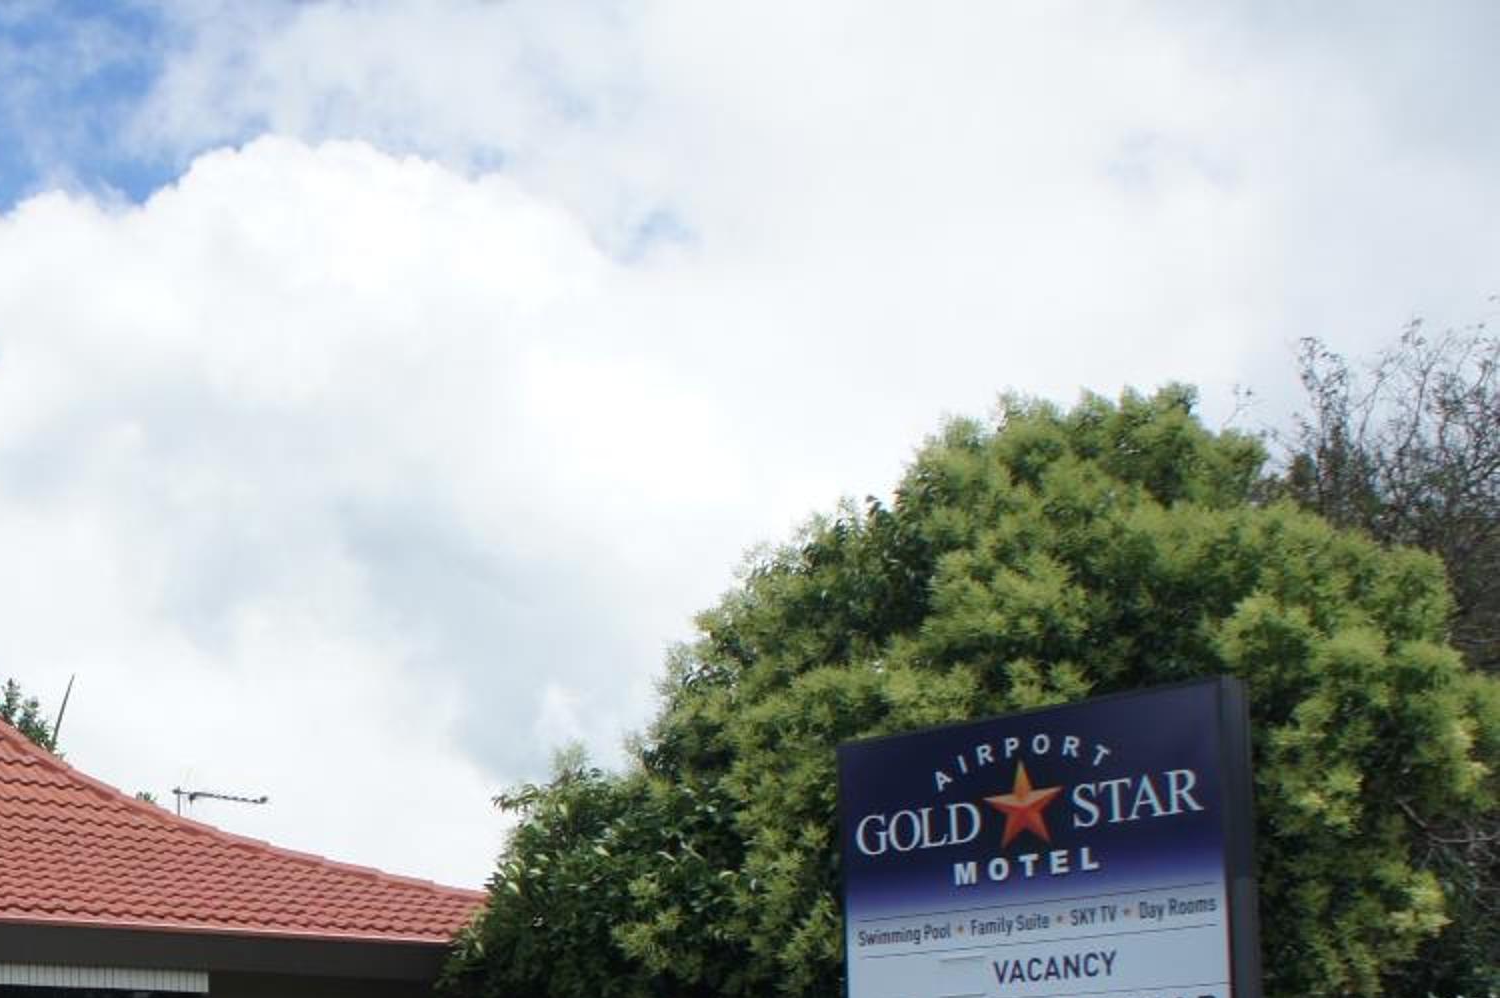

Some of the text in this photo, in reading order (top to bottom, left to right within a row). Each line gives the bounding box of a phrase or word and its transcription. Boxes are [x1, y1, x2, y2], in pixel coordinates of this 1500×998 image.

[933, 734, 1111, 791] AIRPORT
[856, 769, 1204, 856] GOLD STAR
[954, 847, 1100, 886] MOTEL
[858, 898, 1217, 947] Swimming Pool Family Suite SKY TV Day Rooms
[993, 950, 1117, 984] VACANCY
